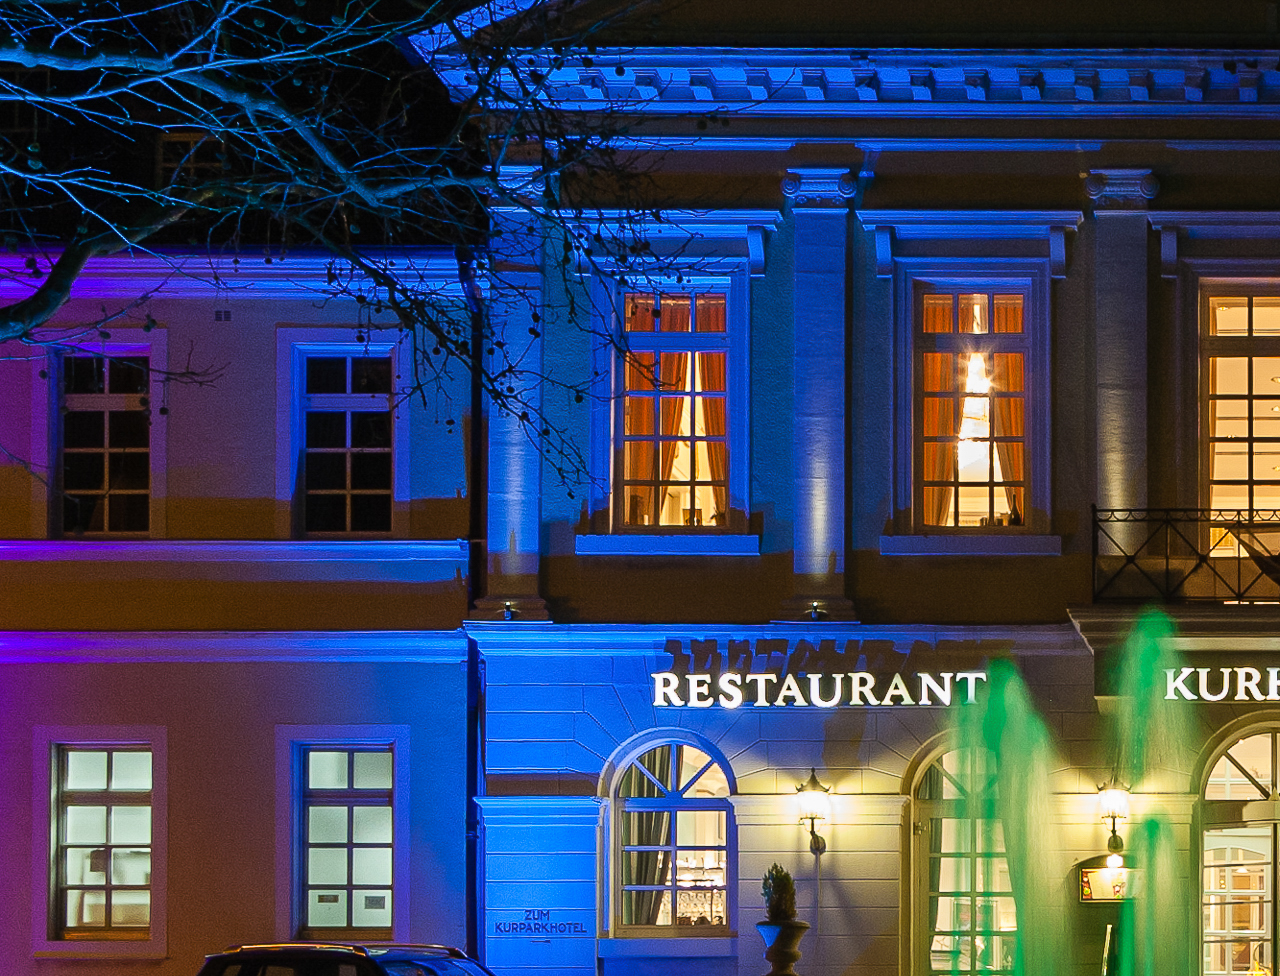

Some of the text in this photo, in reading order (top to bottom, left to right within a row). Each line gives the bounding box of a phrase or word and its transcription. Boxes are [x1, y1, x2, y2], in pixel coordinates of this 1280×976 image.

[651, 672, 987, 709] RESTAURANT
[524, 909, 550, 921] ZUM
[495, 922, 587, 933] KURPARKHOTEL
